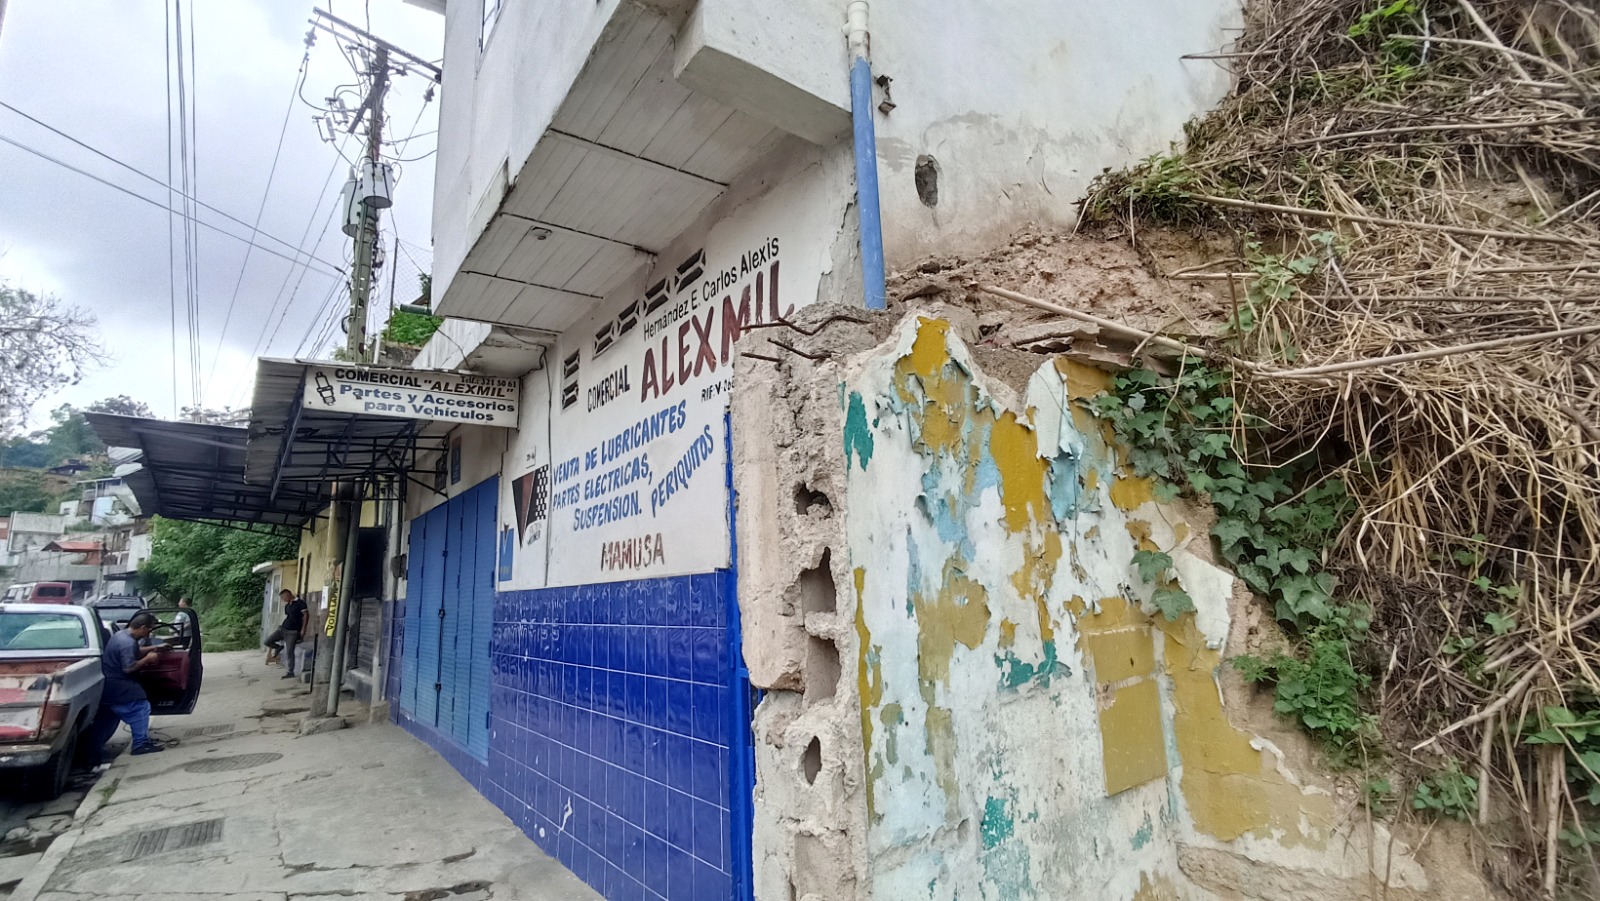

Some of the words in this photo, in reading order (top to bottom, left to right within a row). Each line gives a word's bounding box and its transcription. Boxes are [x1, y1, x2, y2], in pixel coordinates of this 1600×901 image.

[644, 299, 690, 342] Hernández
[691, 289, 701, 312] E.
[702, 267, 737, 302] Carlos
[740, 237, 779, 279] Alexis
[587, 364, 631, 413] COMERCIAL
[641, 260, 795, 403] ALEXMIL
[334, 368, 422, 388] COMERCIAL
[339, 384, 402, 400] Partes
[407, 394, 418, 404] y
[422, 394, 515, 412] Accesorios
[508, 380, 517, 388] 61
[364, 401, 406, 413] para
[412, 404, 495, 422] Vehículos
[553, 456, 580, 486] VENTA
[585, 447, 597, 472] DE
[601, 399, 687, 465] LUBRICANTES
[552, 482, 580, 512] PARTES
[584, 453, 654, 500] ELECTRICAS,
[573, 490, 642, 531] SUSPENSION.
[651, 424, 714, 518] PERIQUITOS
[600, 532, 665, 572] MAMUSA
